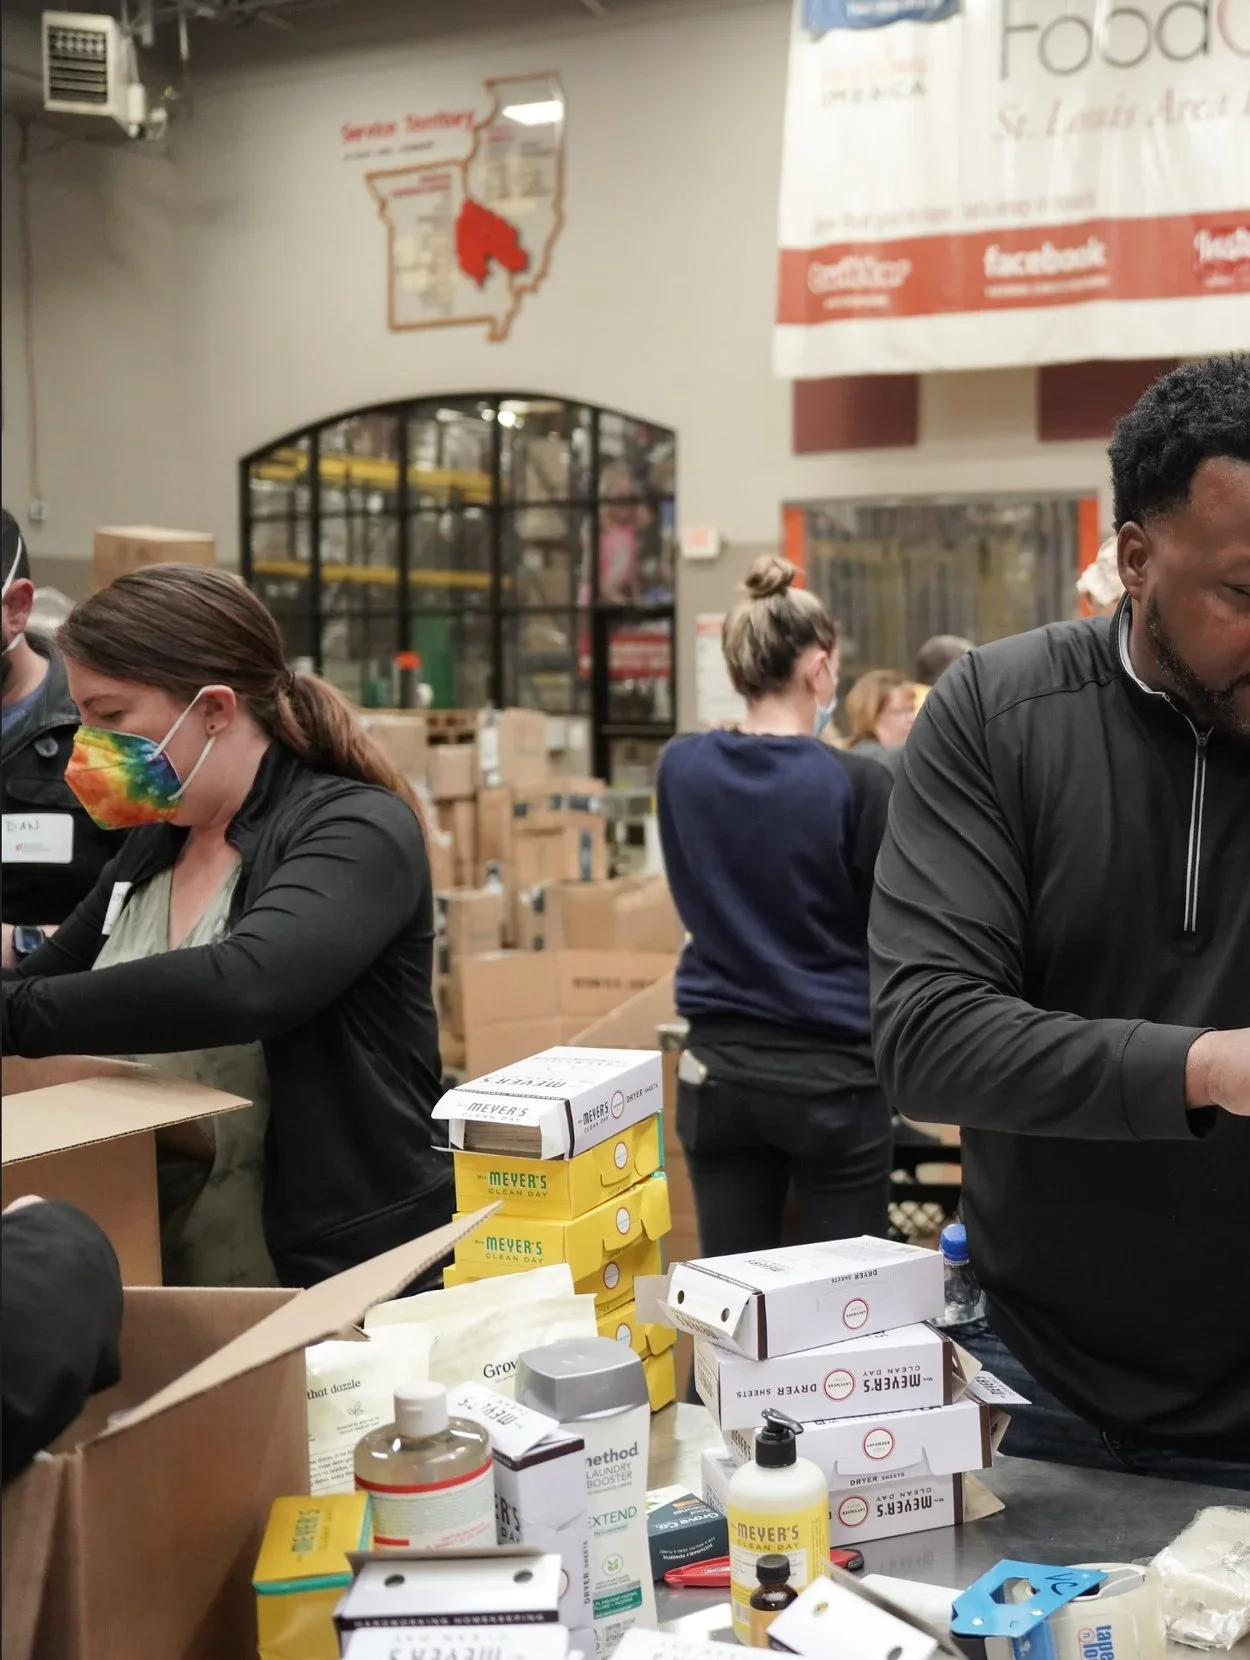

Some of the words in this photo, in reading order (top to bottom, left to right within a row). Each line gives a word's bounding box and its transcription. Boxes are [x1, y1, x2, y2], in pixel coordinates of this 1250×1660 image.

[983, 235, 1107, 278] facebook
[625, 1088, 644, 1104] DRYER
[466, 1102, 530, 1118] MEYER'S
[582, 1100, 610, 1126] MEYER'S
[488, 1170, 548, 1190] MEYER'S
[488, 1188, 523, 1197] CLEAN
[527, 1190, 549, 1199] DAY
[485, 1236, 543, 1256] MEYER'S
[485, 1252, 520, 1263] CLEAN
[523, 1255, 544, 1265] DAY
[831, 1273, 853, 1285] SHEETS
[854, 1269, 878, 1281] DRYER
[862, 1369, 883, 1377] DAY
[887, 1365, 921, 1375] CLEAN
[306, 1387, 328, 1401] that
[330, 1379, 362, 1395] dazzle
[777, 1383, 817, 1397] DRYER
[863, 1373, 922, 1393] MEYER'S
[736, 1388, 772, 1398] SHEETS
[866, 1440, 891, 1448] LAVENDER
[586, 1461, 632, 1480] LAUNDRY
[586, 1470, 633, 1489] BOOSTER
[849, 1475, 879, 1487] DRYER
[881, 1472, 905, 1481] SHEETS
[876, 1493, 895, 1503] DAY
[899, 1487, 932, 1498] CLEAN
[876, 1495, 933, 1518] MEYER'S
[679, 1511, 720, 1525] Grove
[655, 1521, 679, 1530] Co.
[737, 1521, 799, 1543] MEYER'S
[737, 1540, 771, 1552] CLEAN
[777, 1543, 800, 1551] DAY
